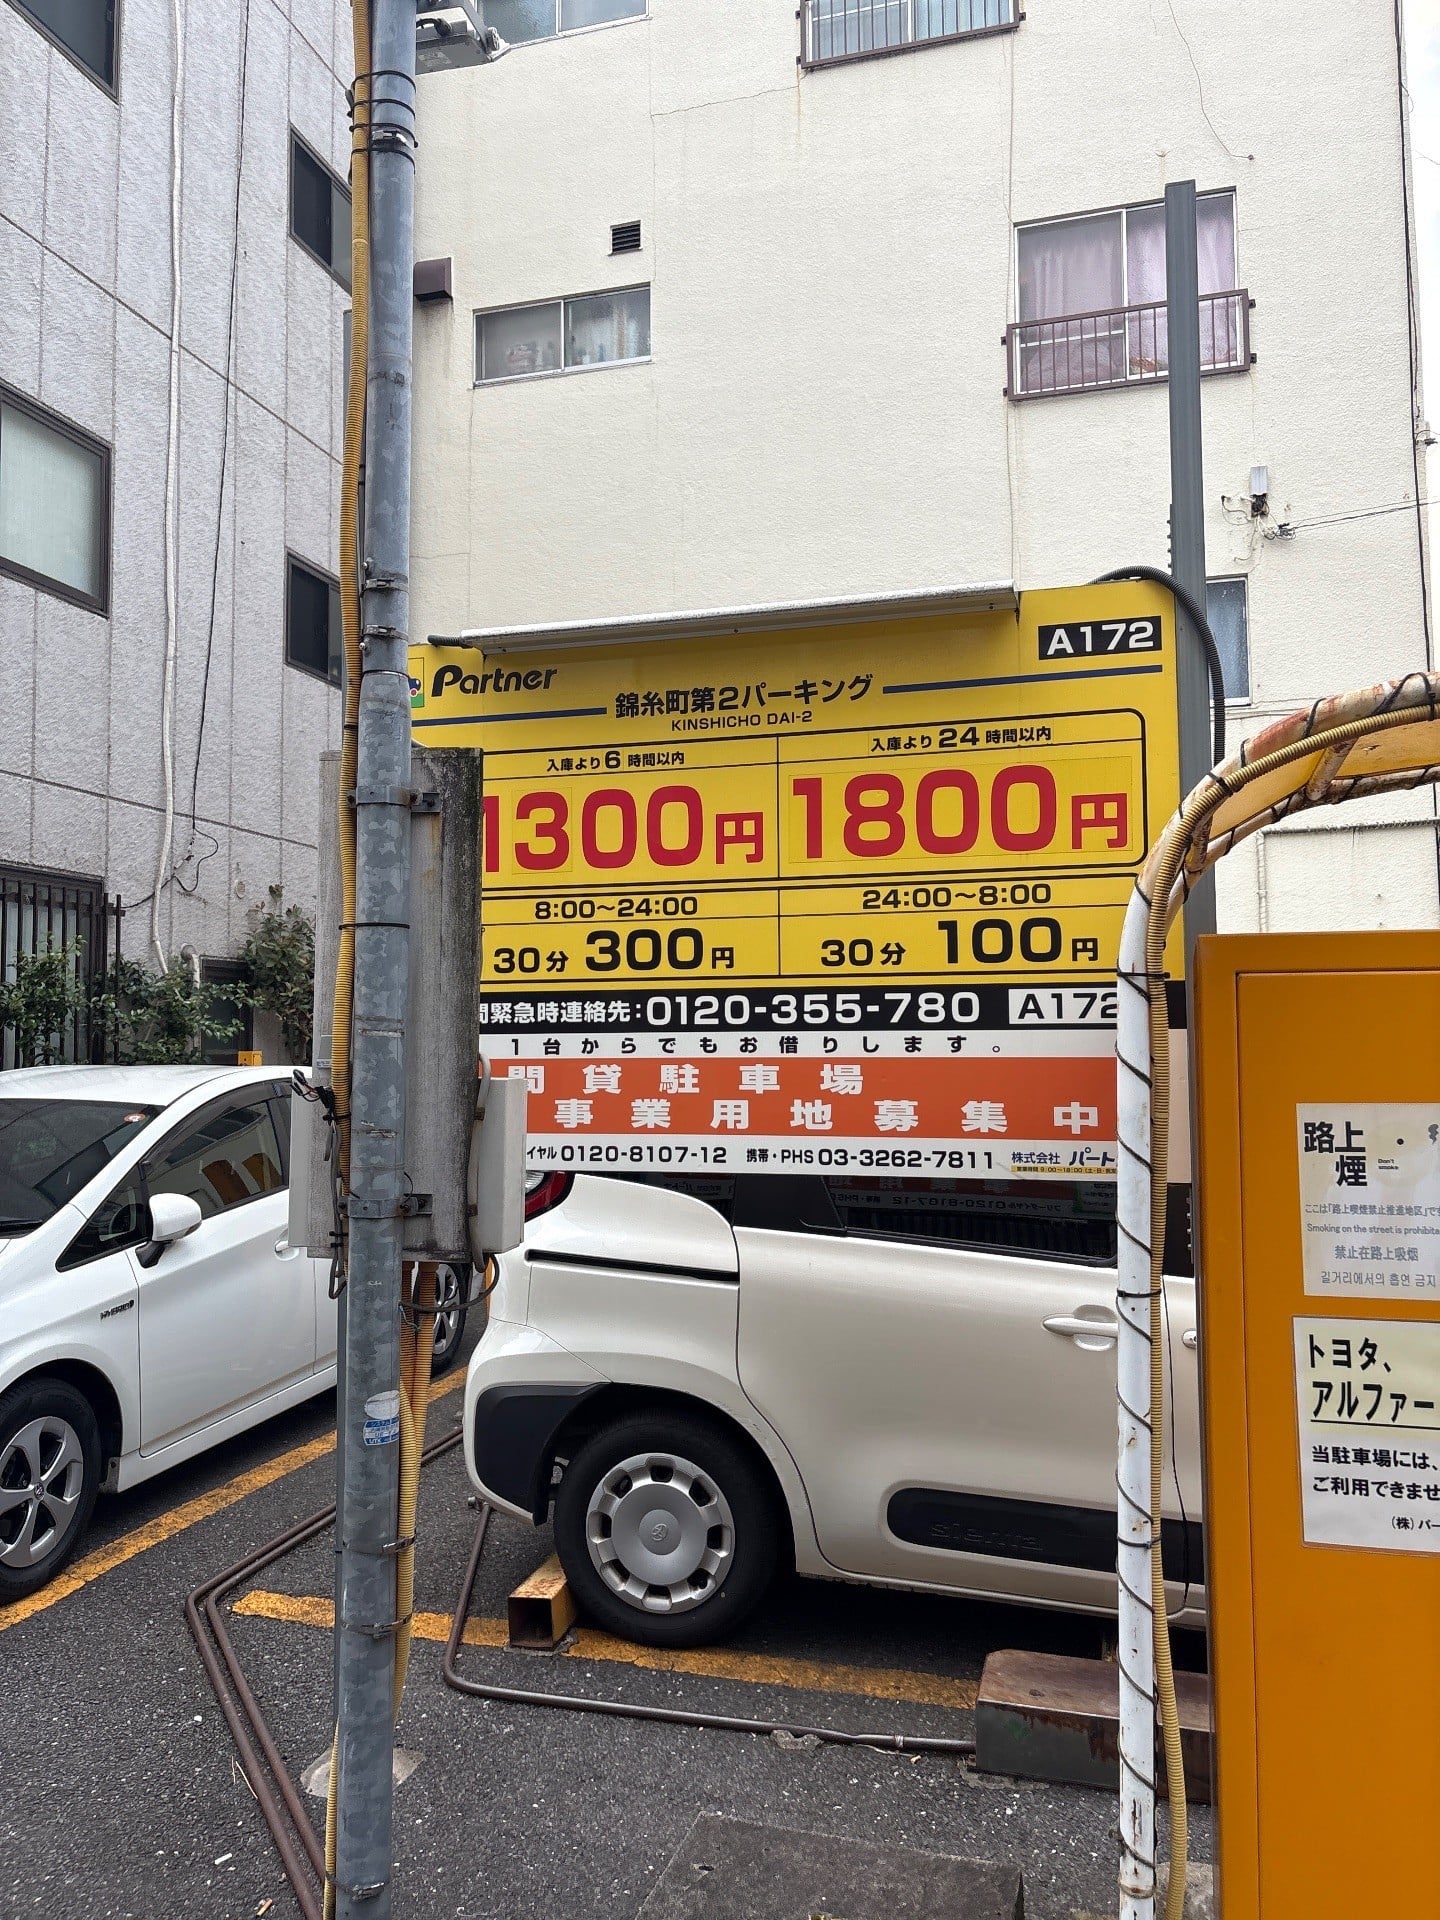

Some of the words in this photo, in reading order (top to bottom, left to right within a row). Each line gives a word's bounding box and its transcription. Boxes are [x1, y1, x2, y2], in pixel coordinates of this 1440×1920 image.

[1046, 621, 1154, 655] A172
[431, 665, 557, 697] Partner
[615, 674, 873, 718] 錦糸町第2パーキング
[671, 714, 761, 731] KINSHICHO
[767, 711, 812, 725] DAI-2
[793, 764, 1128, 859] 1800円
[483, 785, 764, 873] 1300円
[493, 947, 569, 973] 30分
[585, 927, 735, 972] 300円
[820, 938, 906, 967] 30分
[937, 917, 1099, 965] 100円
[1018, 991, 1117, 1019] A172
[554, 1098, 1099, 1135] 事業用地募集中
[1304, 1121, 1366, 1153] 路上
[1011, 1151, 1061, 1165] 株式会社
[1069, 1147, 1116, 1167] パート
[1335, 1154, 1368, 1187] 煙
[1307, 1223, 1341, 1234] Smoking
[1342, 1225, 1352, 1233] on
[1353, 1224, 1367, 1233] the
[1368, 1226, 1394, 1235] street
[1395, 1225, 1402, 1235] is
[1320, 1270, 1385, 1286] 길거리에서의
[1389, 1273, 1410, 1287] 흡연
[1415, 1274, 1437, 1288] 금지
[1308, 1334, 1392, 1373] トヨタ、
[1312, 1381, 1435, 1424] アルファー
[1312, 1445, 1438, 1471] 当駐車場には、
[1312, 1476, 1440, 1501] ご利用できませ
